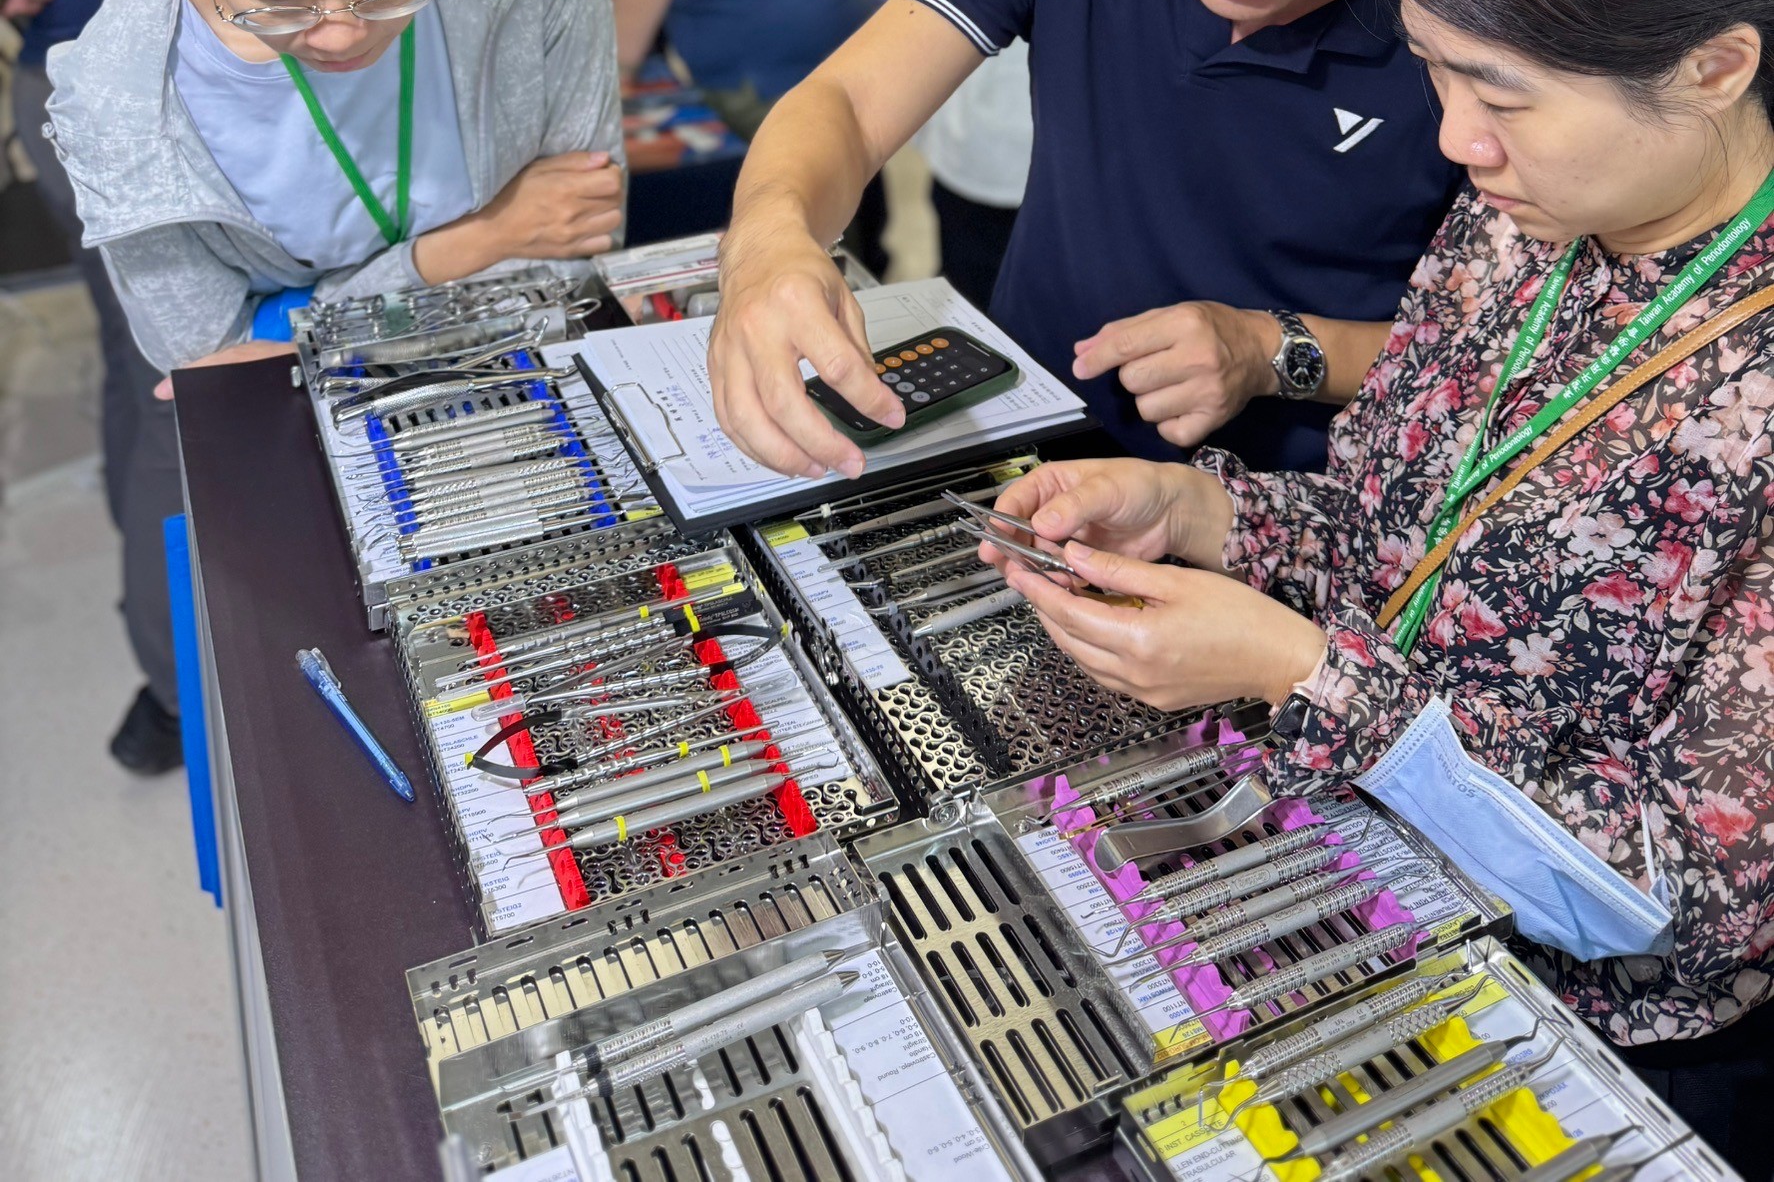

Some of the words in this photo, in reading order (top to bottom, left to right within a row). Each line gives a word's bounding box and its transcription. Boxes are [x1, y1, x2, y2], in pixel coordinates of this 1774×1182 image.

[1636, 301, 1664, 328] Taiwan
[1660, 272, 1695, 306] Academy
[1691, 263, 1703, 275] of
[1701, 217, 1752, 267] Periodontology
[1545, 273, 1562, 299] Taiwan
[1526, 299, 1551, 334] Academy
[1524, 335, 1535, 345] of
[1480, 460, 1489, 470] of
[1487, 424, 1534, 462] Periodontology
[1450, 463, 1467, 488] Taiwan
[1330, 799, 1364, 817] UNIVERSITY
[1400, 873, 1437, 893] PERIOSTEAL
[1421, 880, 1443, 893] MICRO
[1428, 887, 1450, 900] URBAN
[866, 958, 880, 968] 10-0
[868, 978, 893, 993] Straight
[869, 975, 880, 983] cm
[862, 984, 897, 1004] Castroviejo
[1161, 999, 1185, 1012] NT1100
[899, 1014, 913, 1025] 10-0
[901, 1035, 927, 1051] Straight
[902, 1032, 913, 1040] cm
[908, 1043, 931, 1057] Handle
[898, 1050, 936, 1071] Castroviejo,
[876, 1067, 898, 1081] Round
[964, 1138, 975, 1147] cm
[976, 1134, 984, 1142] 15
[1164, 1138, 1182, 1151] INST
[926, 1144, 939, 1155] 6-0
[952, 1142, 990, 1164] Crile-Wood
[1193, 1134, 1244, 1162] END-CUTTING
